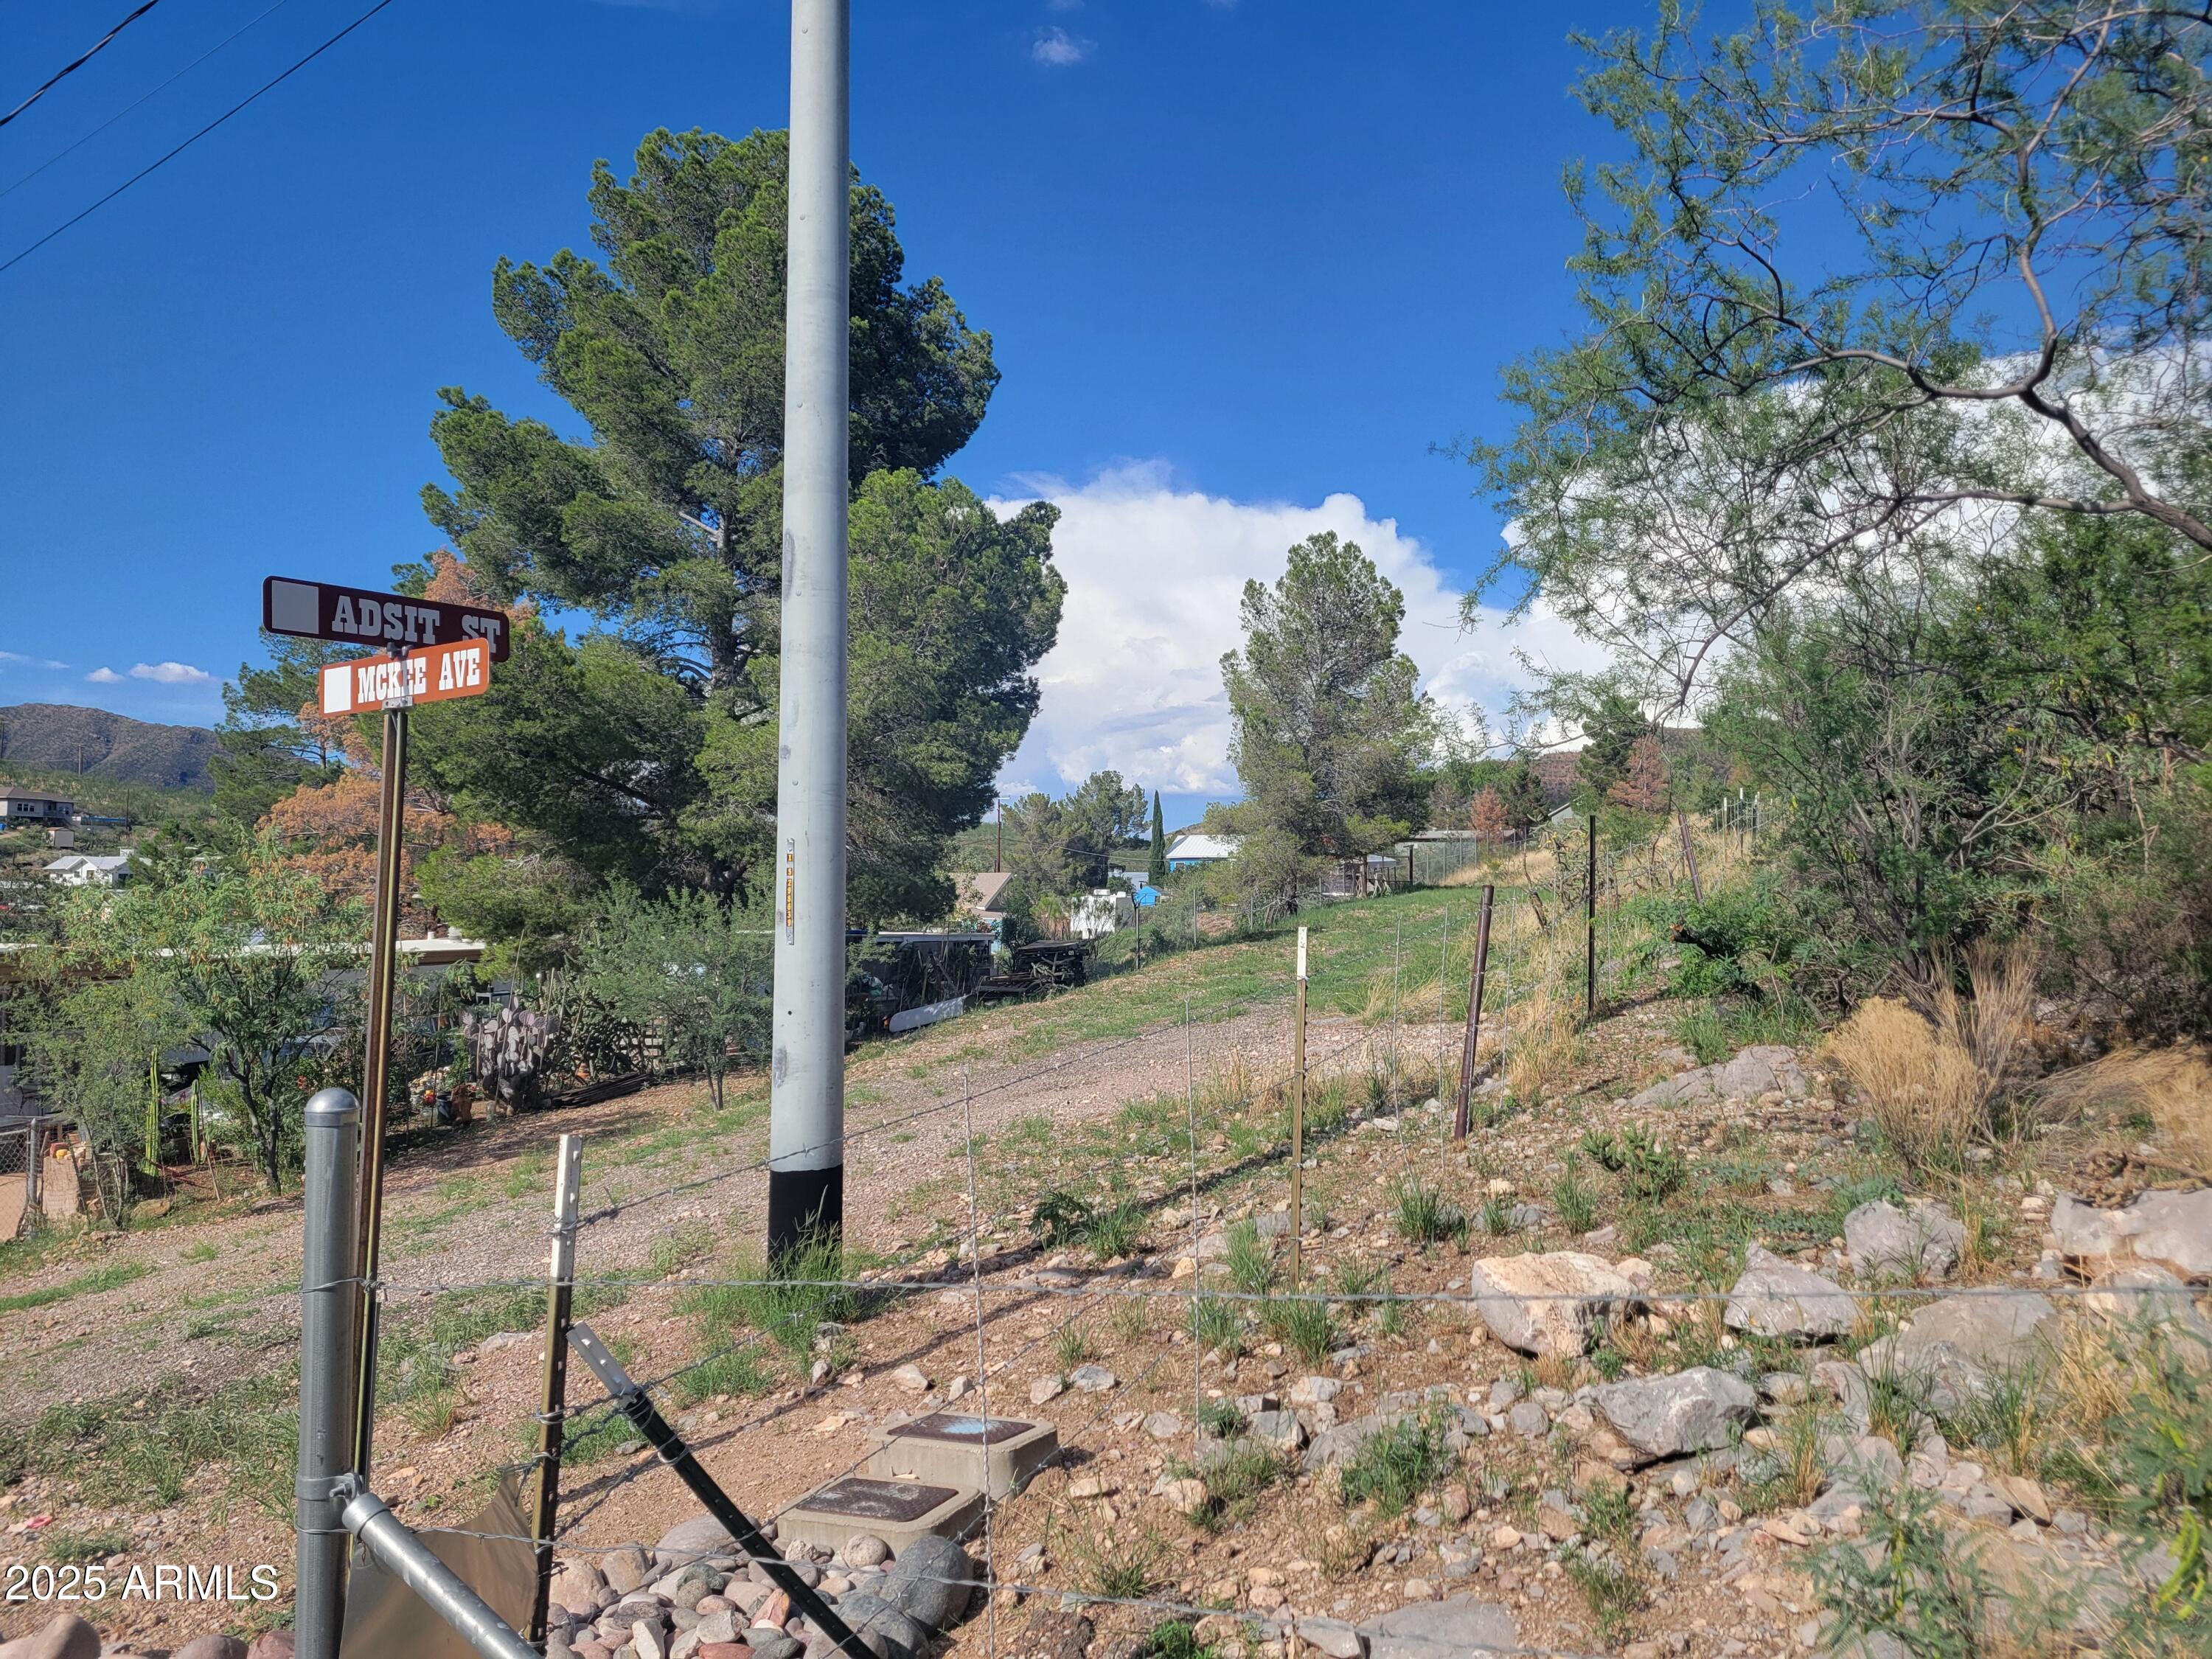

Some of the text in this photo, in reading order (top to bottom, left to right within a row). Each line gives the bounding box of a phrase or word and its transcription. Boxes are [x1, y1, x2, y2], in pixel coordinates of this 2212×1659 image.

[331, 595, 501, 654] ADSIT ST
[438, 647, 481, 692] AVE
